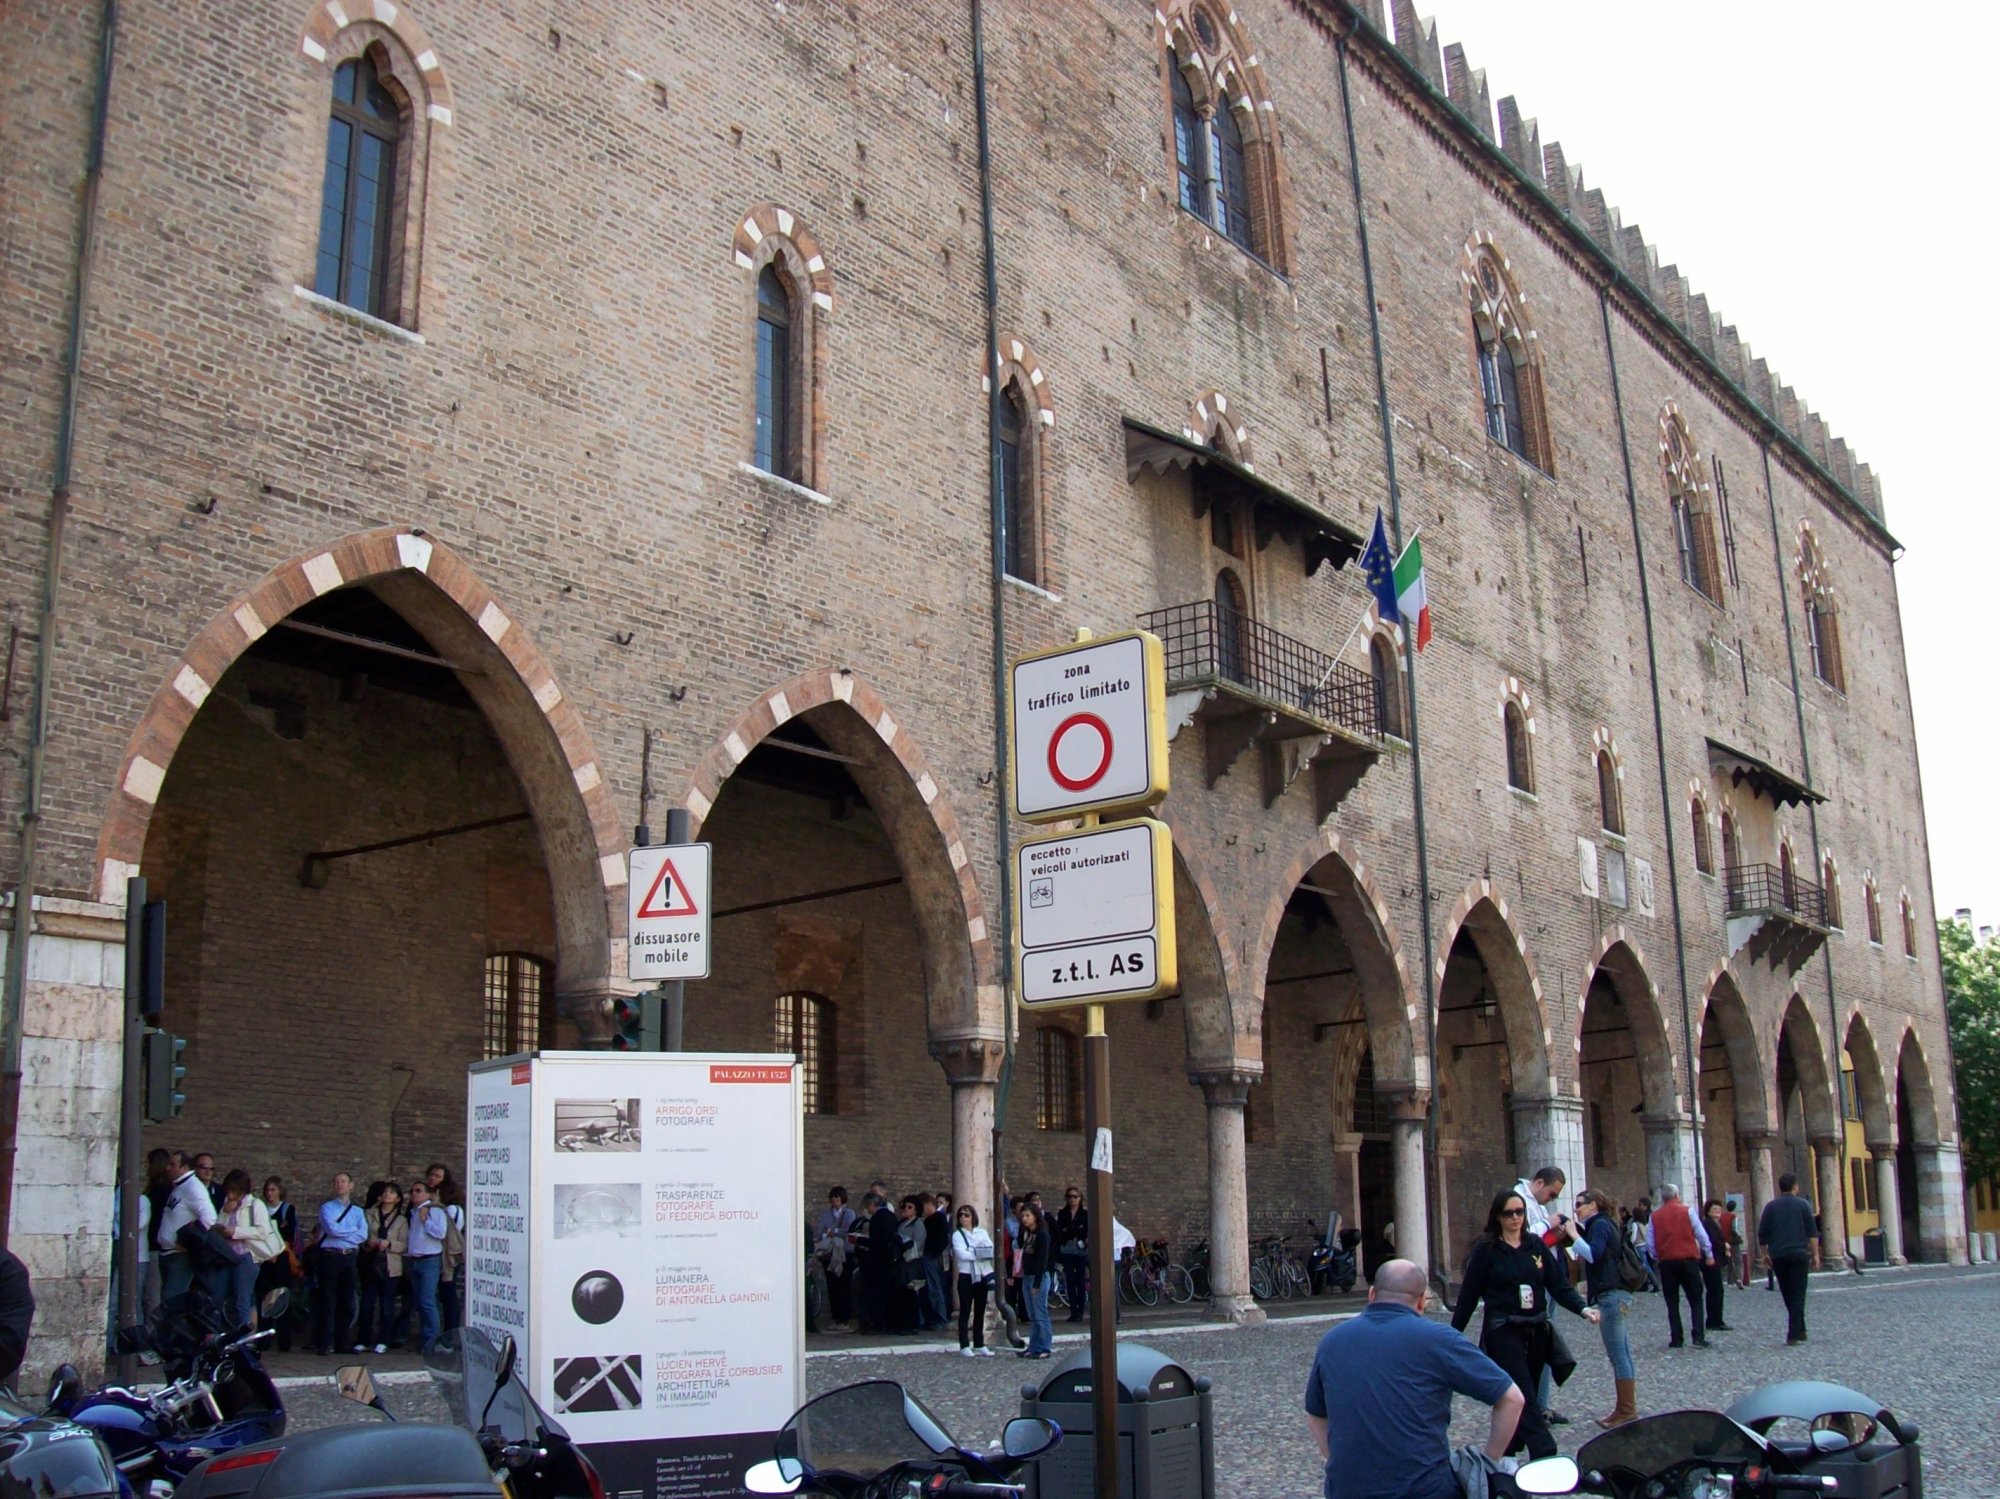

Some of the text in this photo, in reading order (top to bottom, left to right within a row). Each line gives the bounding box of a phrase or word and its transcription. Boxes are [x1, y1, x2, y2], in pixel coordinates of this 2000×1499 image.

[1064, 664, 1091, 678] zona
[1028, 678, 1130, 711] traffico limitato
[1030, 846, 1072, 860] eccetto
[1031, 850, 1130, 876] veicoli autorizzati
[634, 932, 700, 946] dissuasore
[644, 948, 688, 964] mobile
[1052, 952, 1144, 984] z.t.l. AS
[714, 1070, 788, 1079] PALAZZO TE 1525
[475, 1102, 510, 1120] FOTOGRAFARE
[656, 1105, 718, 1115] ARRIGO ORSI
[656, 1116, 715, 1126] FOTOGRAFIE
[474, 1126, 498, 1142] SIGNIFICA
[474, 1147, 510, 1164] APPROPRIARSI
[474, 1170, 504, 1186] DELLA COSA
[474, 1192, 483, 1207] CHE
[484, 1192, 489, 1208] SI
[656, 1190, 725, 1200] TRASPARENZE
[656, 1201, 715, 1211] FOTOGRAFIE
[473, 1213, 524, 1233] SIGNIFICA STABILIRE
[656, 1210, 758, 1221] DI FEDERICA BOTTOLI
[473, 1234, 510, 1254] CON IL MONDO
[473, 1256, 512, 1278] UNA RELAZIONE
[656, 1274, 709, 1284] LUNANERA
[473, 1278, 518, 1303] PARTICOLARE CHE
[656, 1284, 715, 1295] FOTOGRAFIE
[656, 1292, 770, 1306] DI ANTONELLA GANDINI
[480, 1301, 491, 1318] UNA
[492, 1304, 524, 1328] SENSAZIONE
[656, 1357, 727, 1370] LUCIEN HERVÉ
[656, 1365, 783, 1381] FOTOGRAFA LE CORBUSIER
[656, 1379, 730, 1391] ARCHITETTURA
[656, 1390, 717, 1402] IN IMMAGINI
